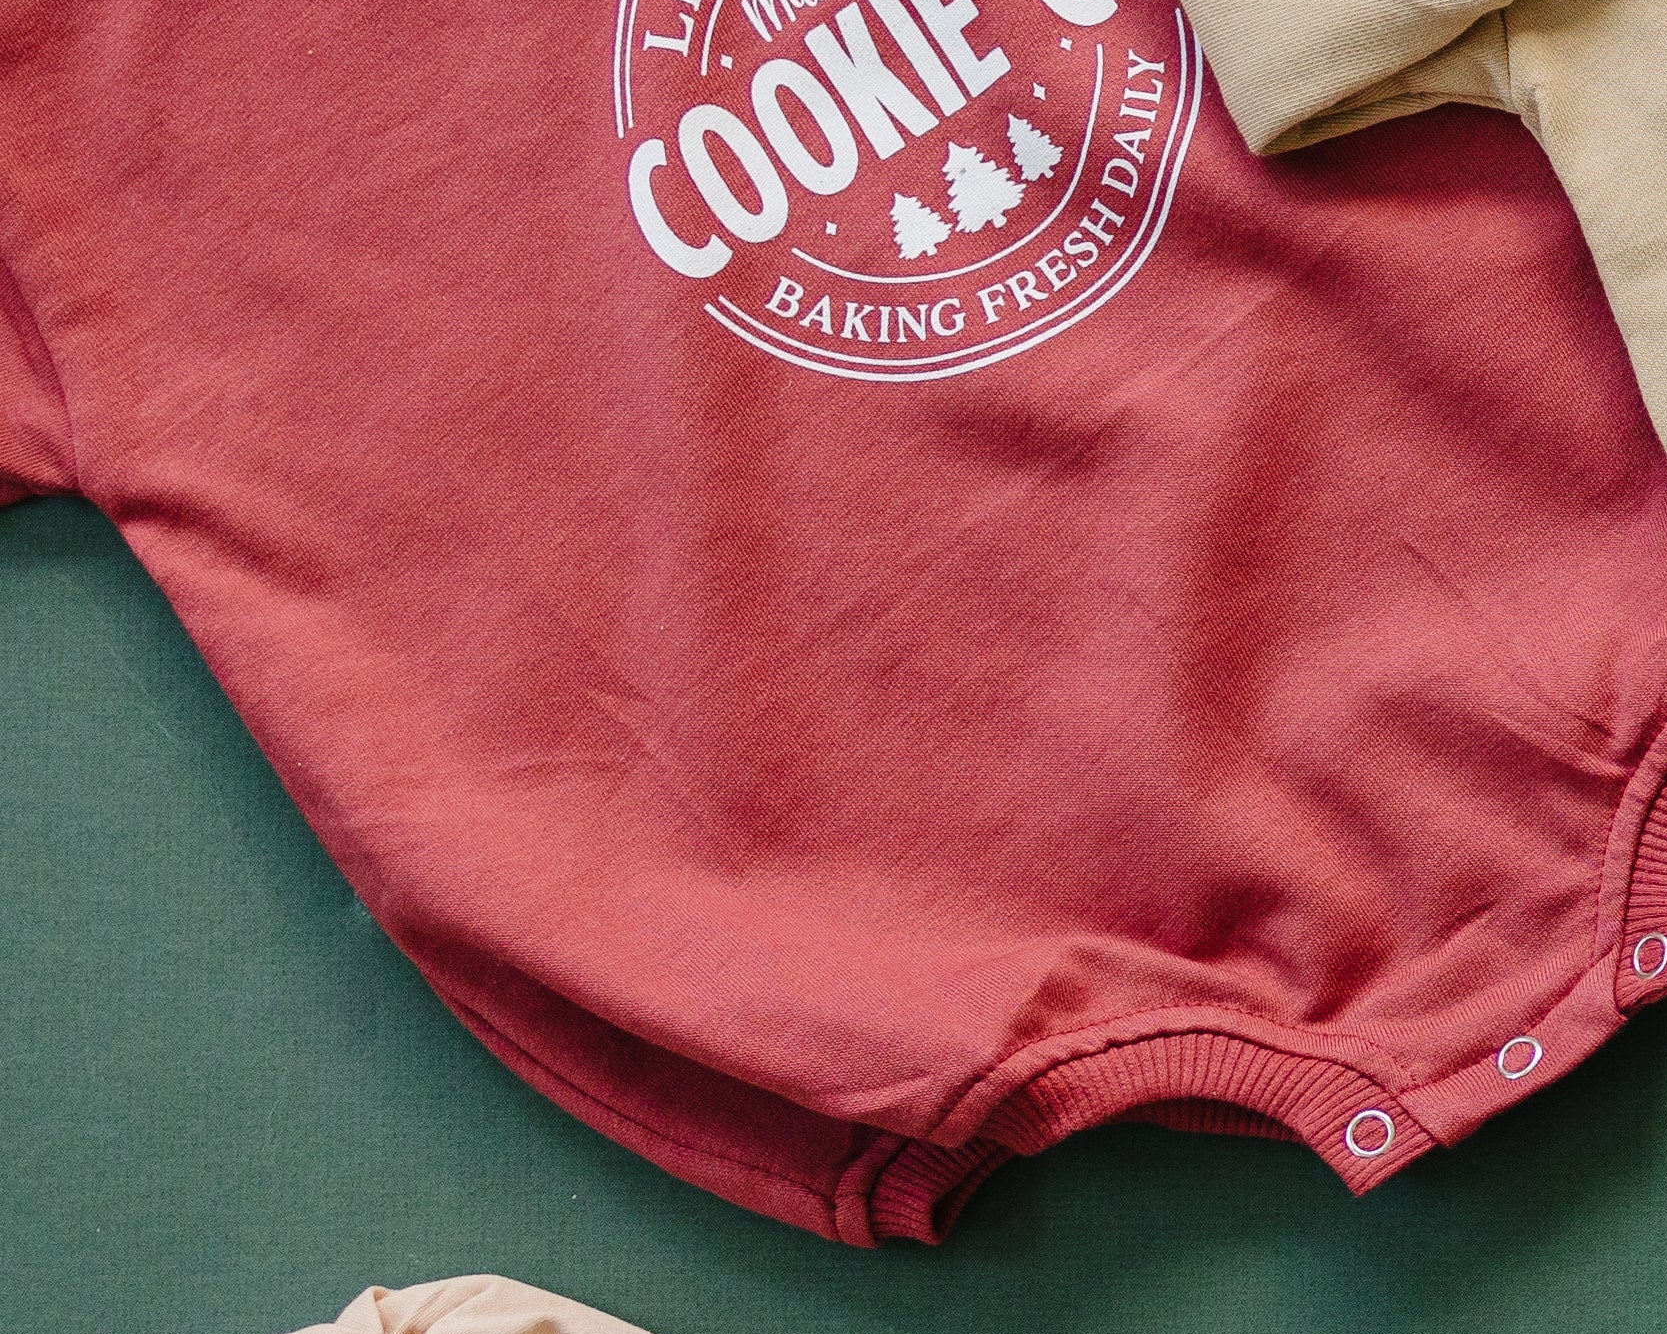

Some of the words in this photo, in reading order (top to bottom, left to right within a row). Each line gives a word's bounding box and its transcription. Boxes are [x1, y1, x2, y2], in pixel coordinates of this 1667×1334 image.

[764, 275, 965, 344] BAKING
[983, 197, 1125, 326] FRESH
[1101, 48, 1166, 200] DAILY
